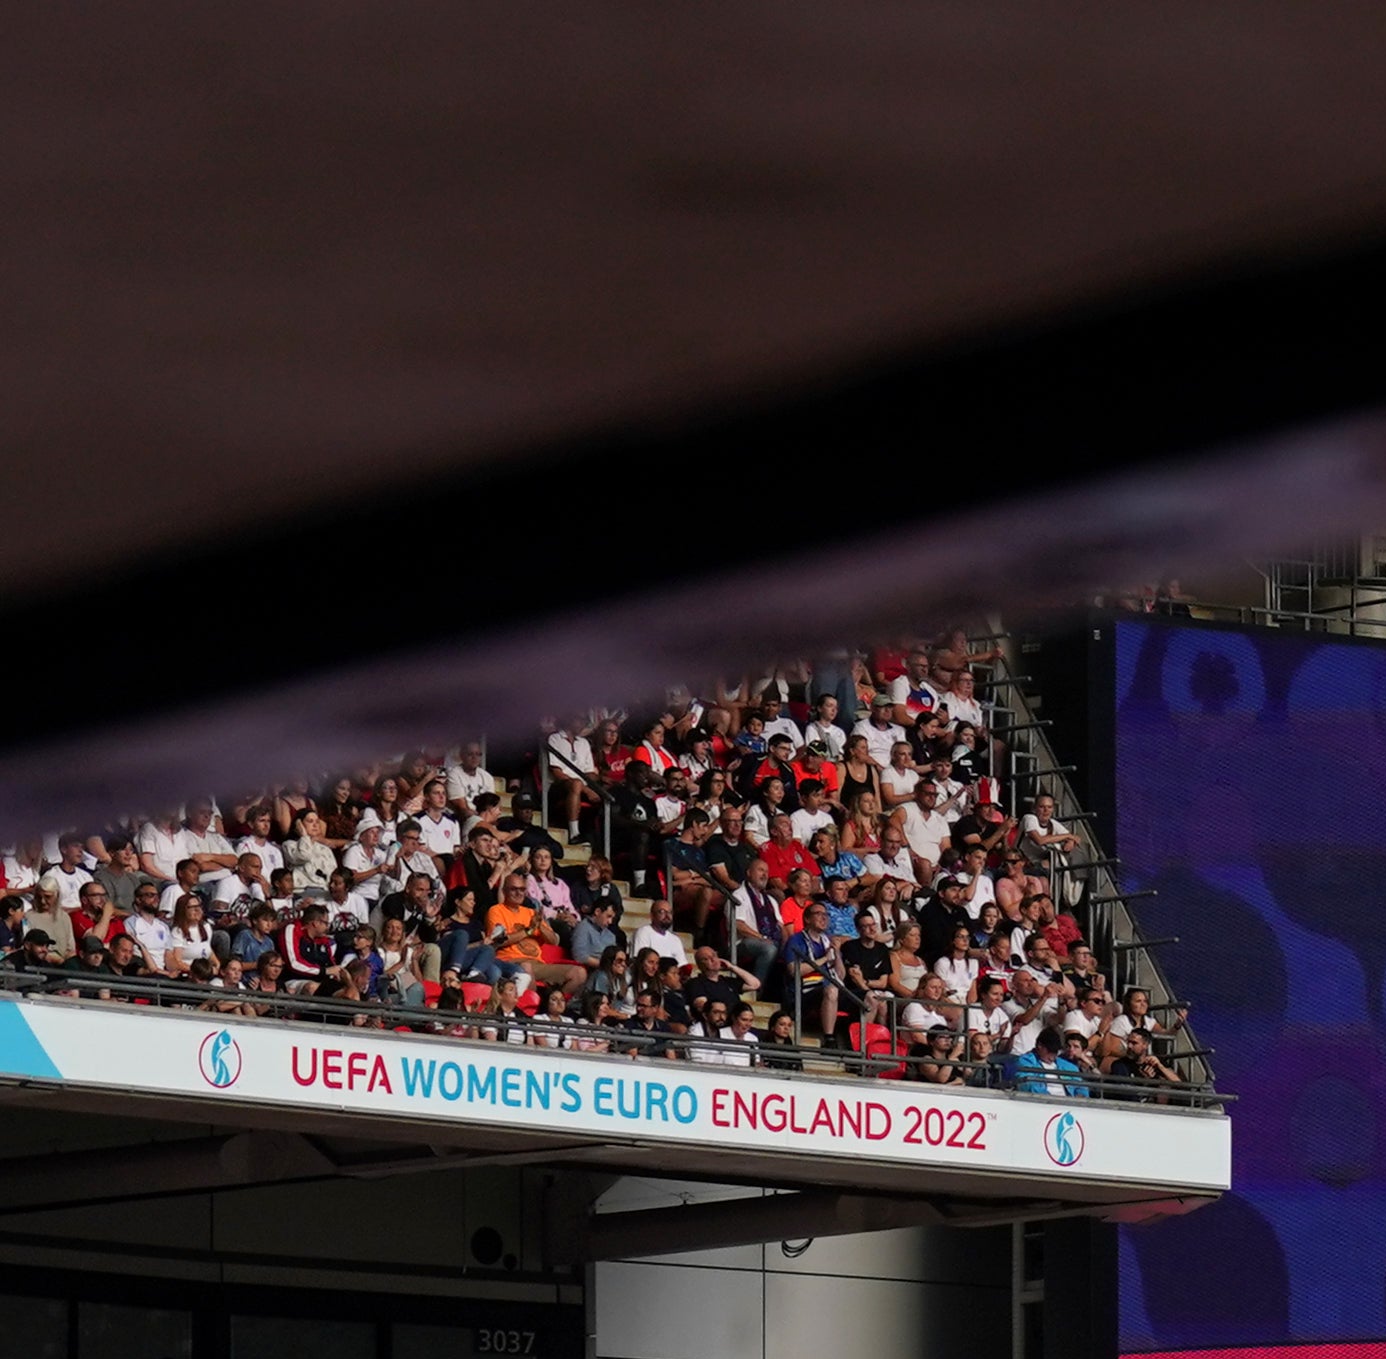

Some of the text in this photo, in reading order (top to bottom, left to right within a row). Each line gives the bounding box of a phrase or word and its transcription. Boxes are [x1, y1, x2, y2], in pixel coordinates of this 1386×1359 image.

[291, 1046, 393, 1095] UEFA
[401, 1056, 583, 1114] WOMEN'S
[593, 1077, 700, 1125] EURO
[711, 1088, 892, 1141] ENGLAND
[479, 1329, 536, 1354] 3037
